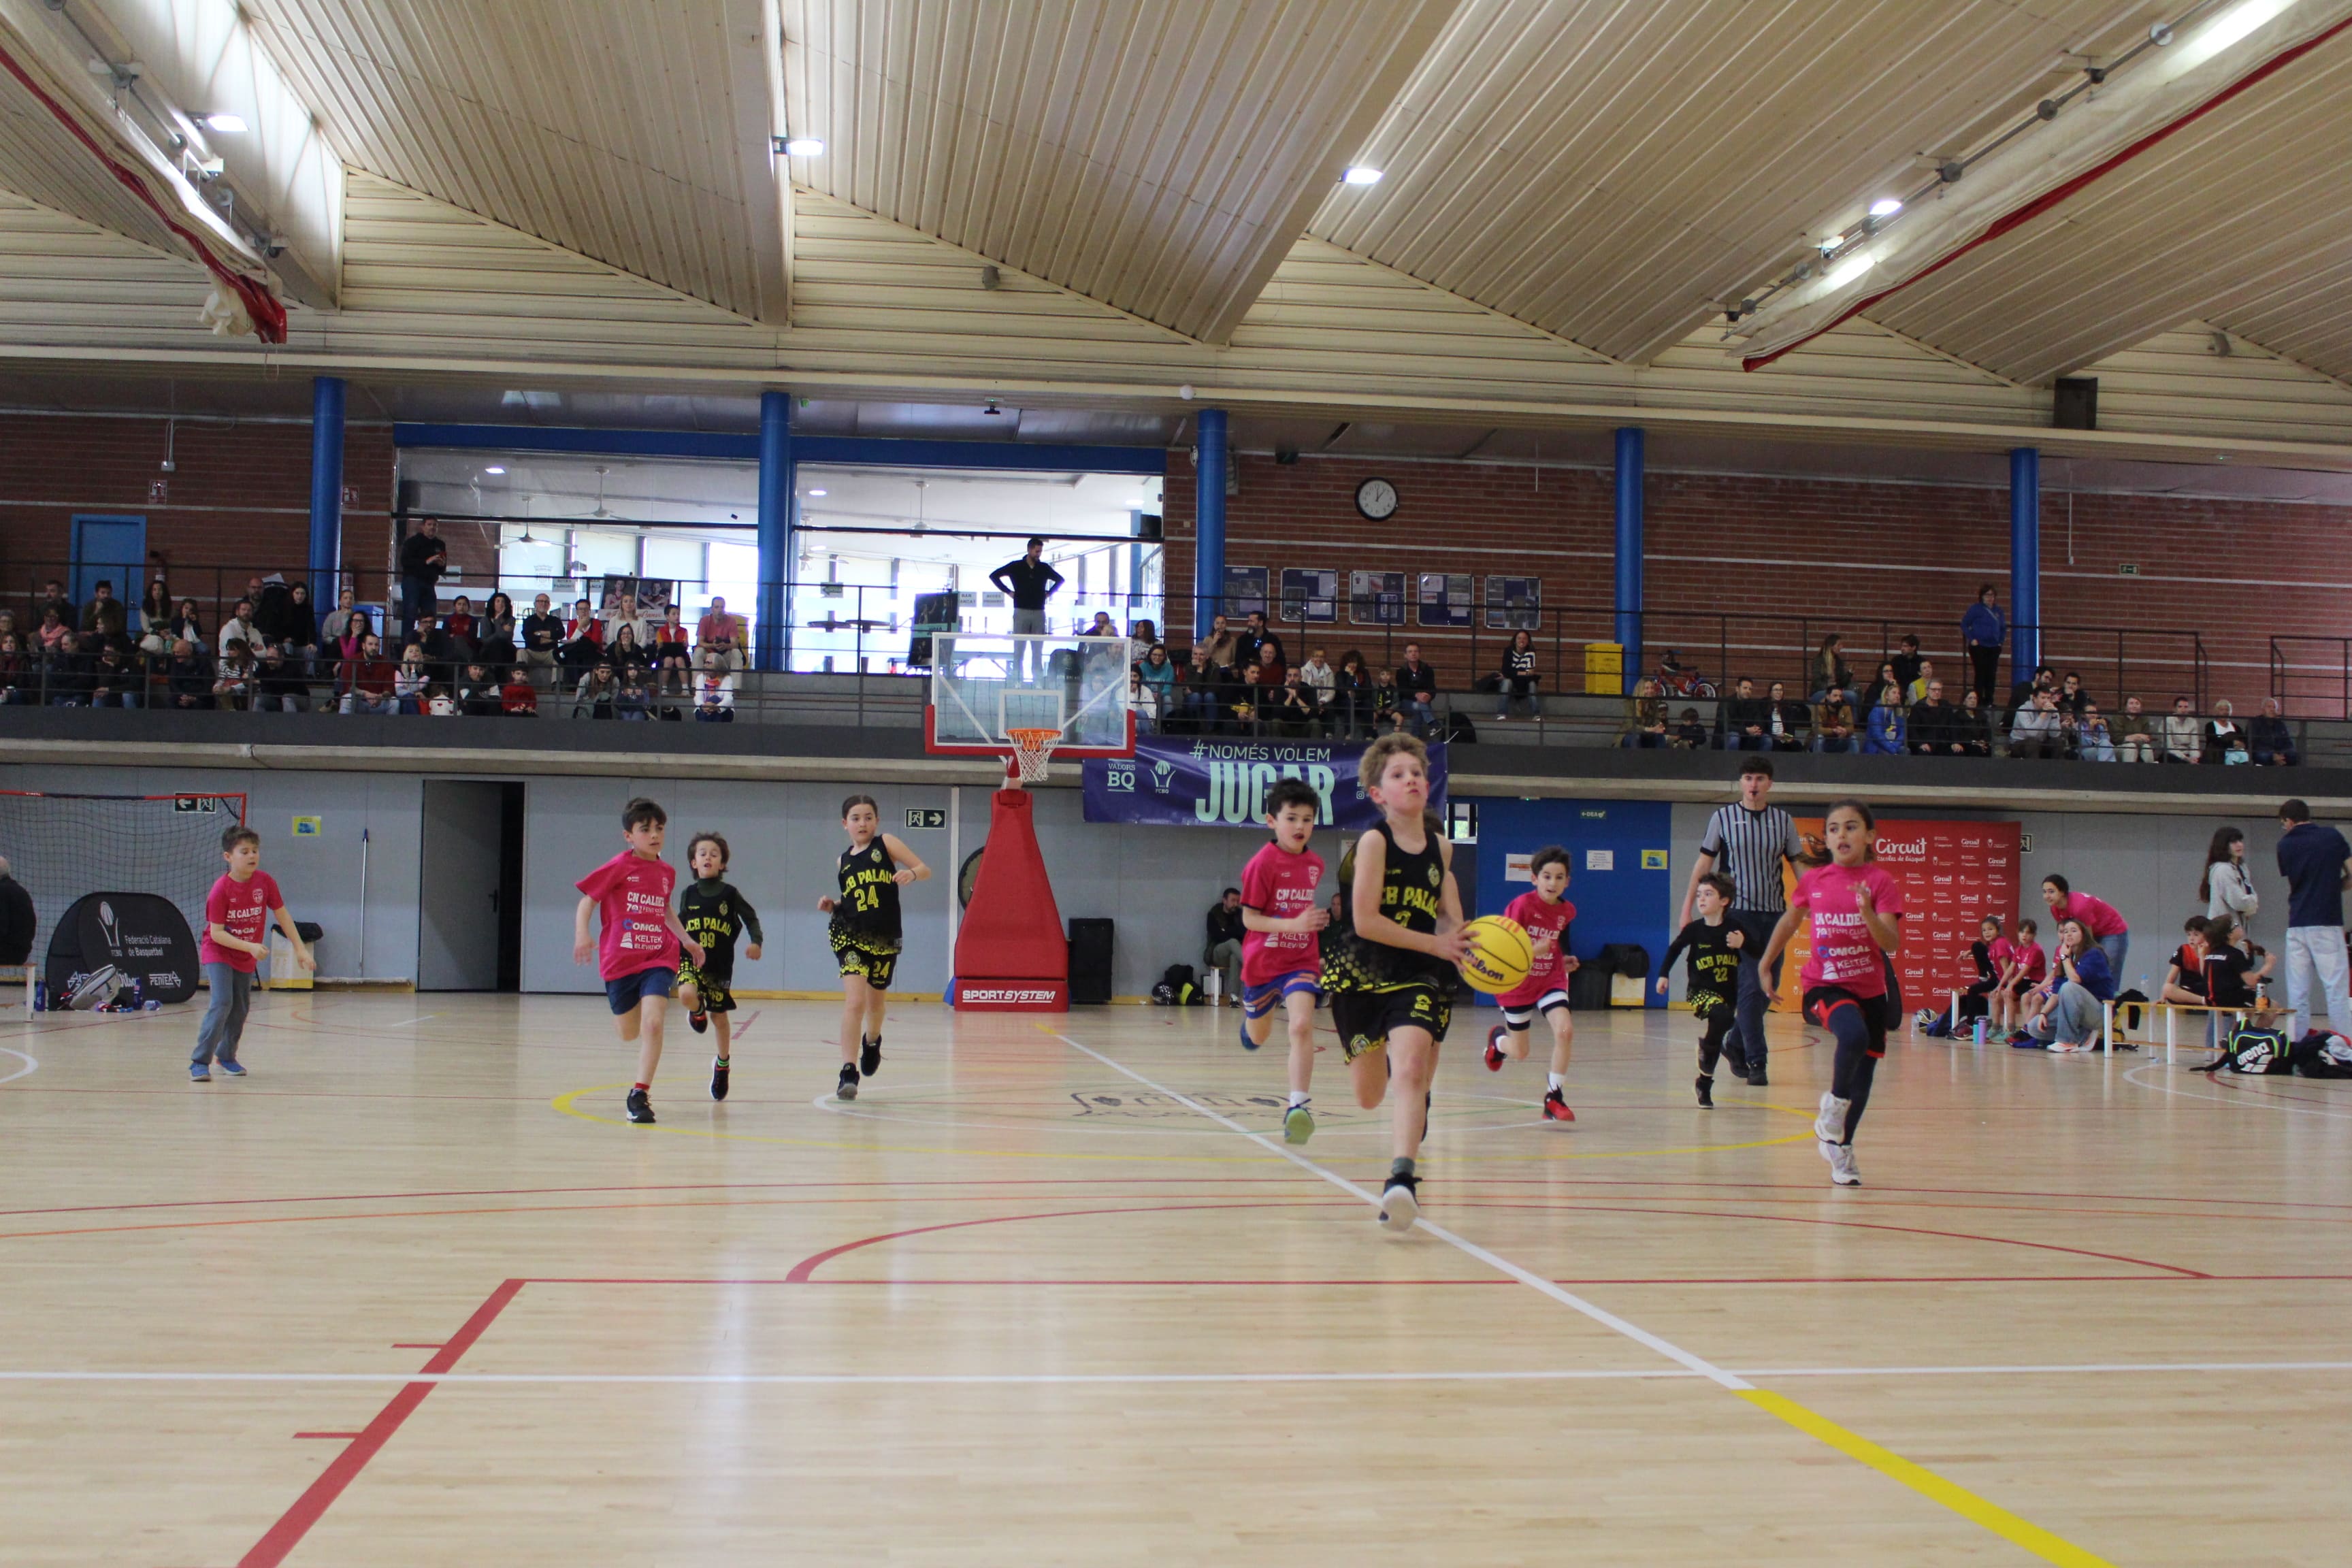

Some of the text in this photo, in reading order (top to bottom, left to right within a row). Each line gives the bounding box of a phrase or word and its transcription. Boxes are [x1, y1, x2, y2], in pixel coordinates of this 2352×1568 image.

[1274, 747, 1330, 762] VOLEM
[1109, 763, 1135, 771] VALORS
[1107, 772, 1135, 790] BQ
[1876, 838, 1927, 854] Circuit
[857, 868, 892, 885] PALAU
[627, 892, 639, 902] CN
[854, 885, 879, 912] 24
[704, 917, 732, 936] PALAU
[700, 932, 715, 948] 99
[874, 960, 891, 978] 24
[1696, 956, 1714, 971] ACB
[1713, 966, 1728, 983] 22
[962, 990, 1056, 1003] SPORTSYSTEM
[2237, 1041, 2270, 1066] arena
